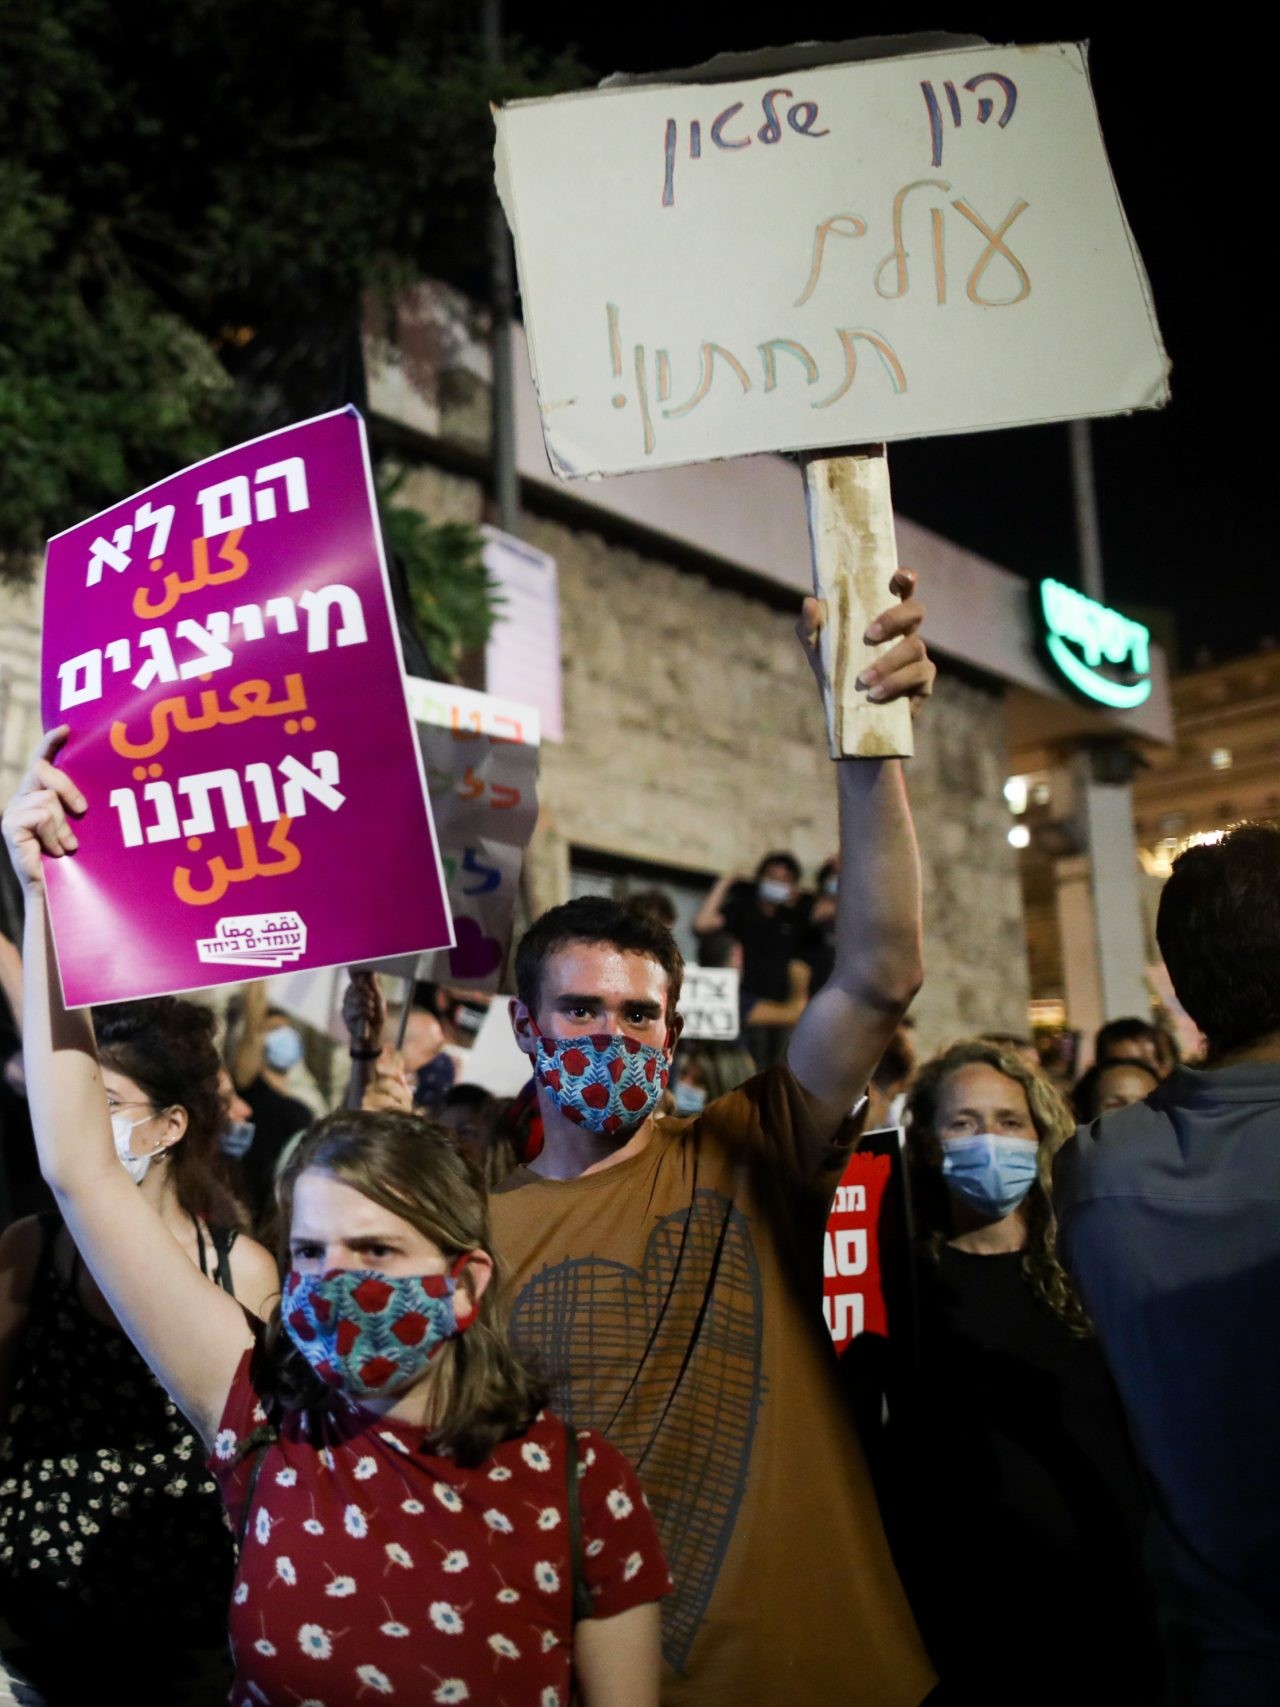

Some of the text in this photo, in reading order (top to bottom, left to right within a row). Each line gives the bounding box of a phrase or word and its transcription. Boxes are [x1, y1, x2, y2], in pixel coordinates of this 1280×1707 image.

[920, 72, 1018, 168] הון
[793, 179, 1031, 307] עולם
[605, 301, 909, 454] תחתון!
[86, 457, 310, 587] הם לא
[132, 526, 250, 619] كلن
[57, 583, 368, 711] מייצגים
[110, 672, 317, 781] يعني
[110, 750, 346, 848] אותנו
[173, 812, 302, 906] كلن
[202, 932, 300, 953] עומדים ביחד
